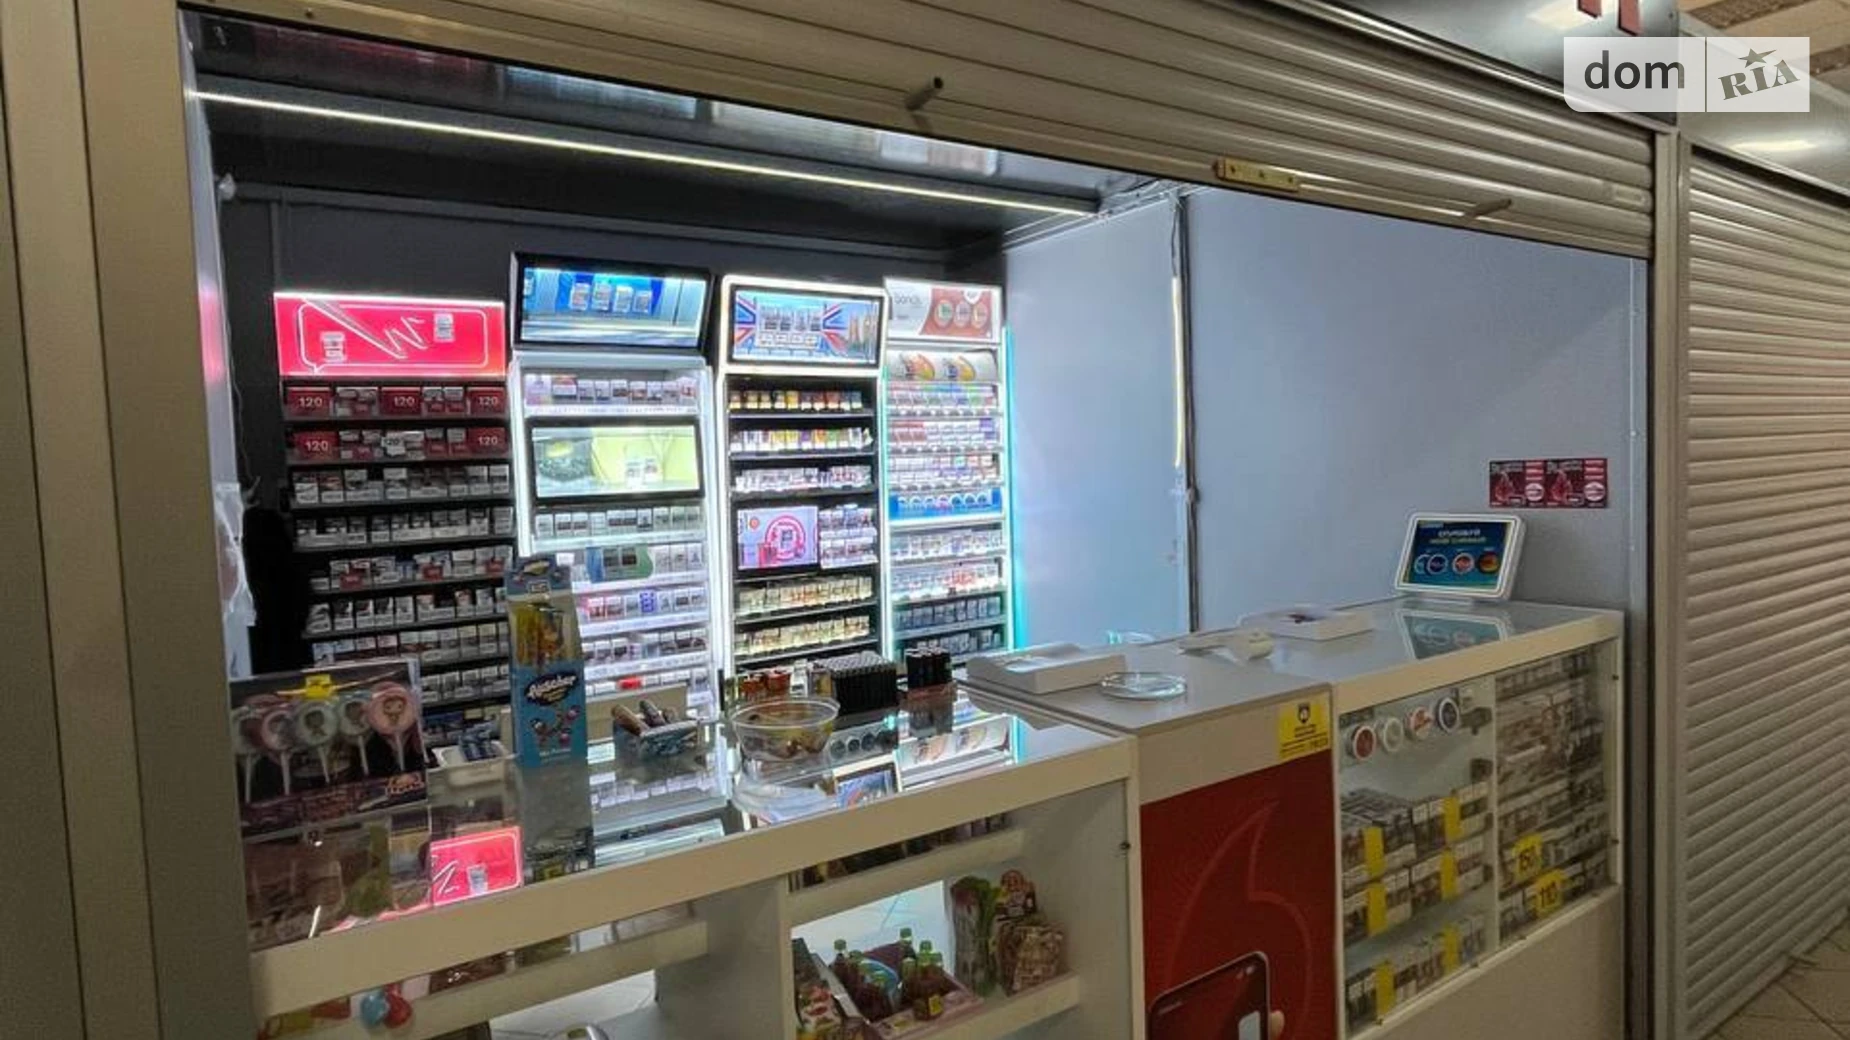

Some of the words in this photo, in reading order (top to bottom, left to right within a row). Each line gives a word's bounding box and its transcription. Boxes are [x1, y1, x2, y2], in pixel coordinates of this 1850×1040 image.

[299, 397, 323, 408] 120
[393, 396, 415, 408] 120
[478, 396, 498, 406] 120
[306, 440, 328, 451] 120
[477, 436, 498, 446] 120
